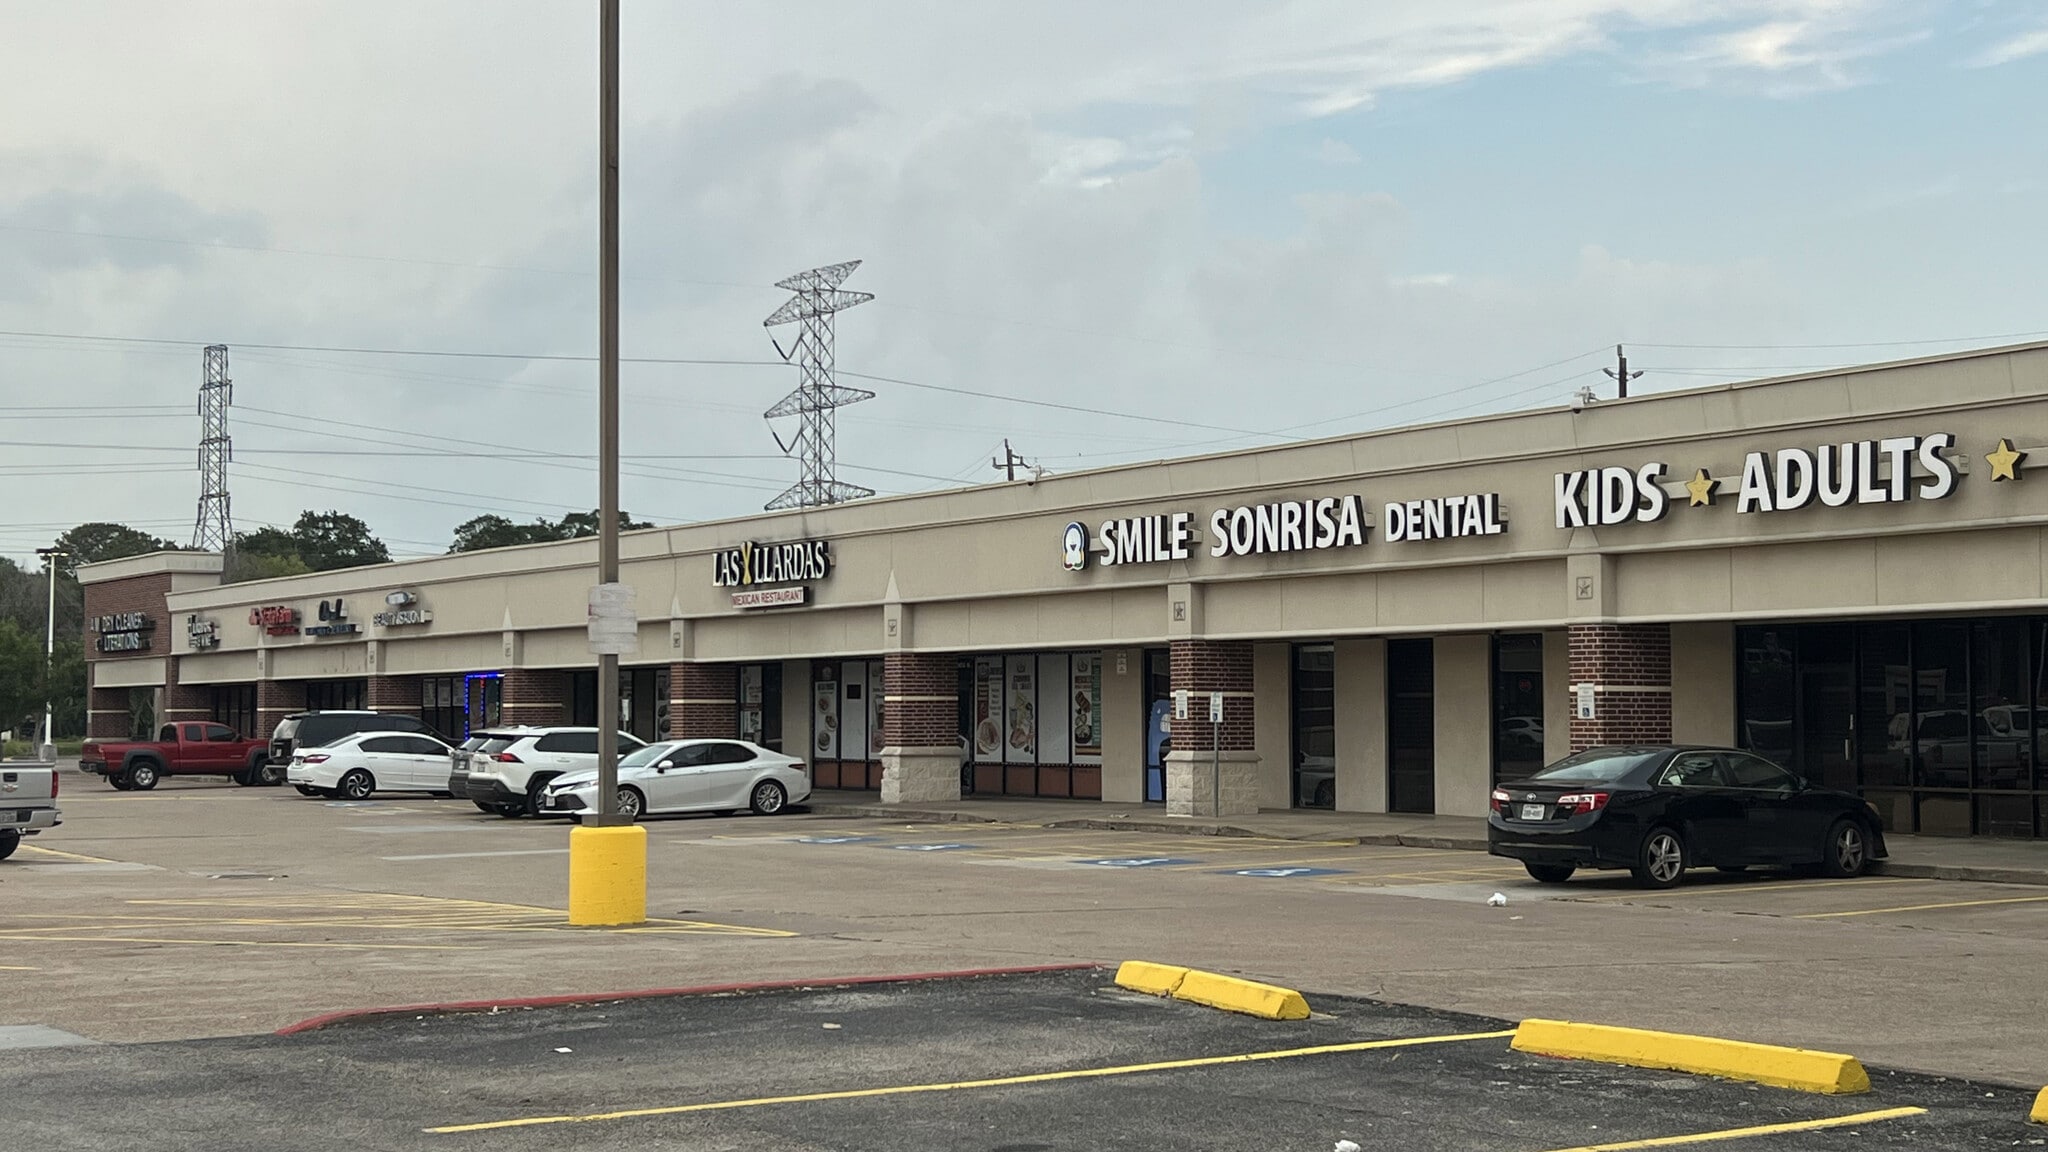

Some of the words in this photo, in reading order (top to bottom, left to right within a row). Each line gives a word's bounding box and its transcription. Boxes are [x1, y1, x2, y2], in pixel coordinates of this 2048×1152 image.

[1553, 462, 1668, 529] KIDS
[1736, 432, 1959, 514] ADULTS
[1099, 512, 1196, 566] SMILE
[1210, 494, 1366, 558] SONRISA
[1384, 493, 1507, 543] DENTAL
[732, 592, 760, 606] MEXICAN
[760, 588, 804, 604] RESTAURANT
